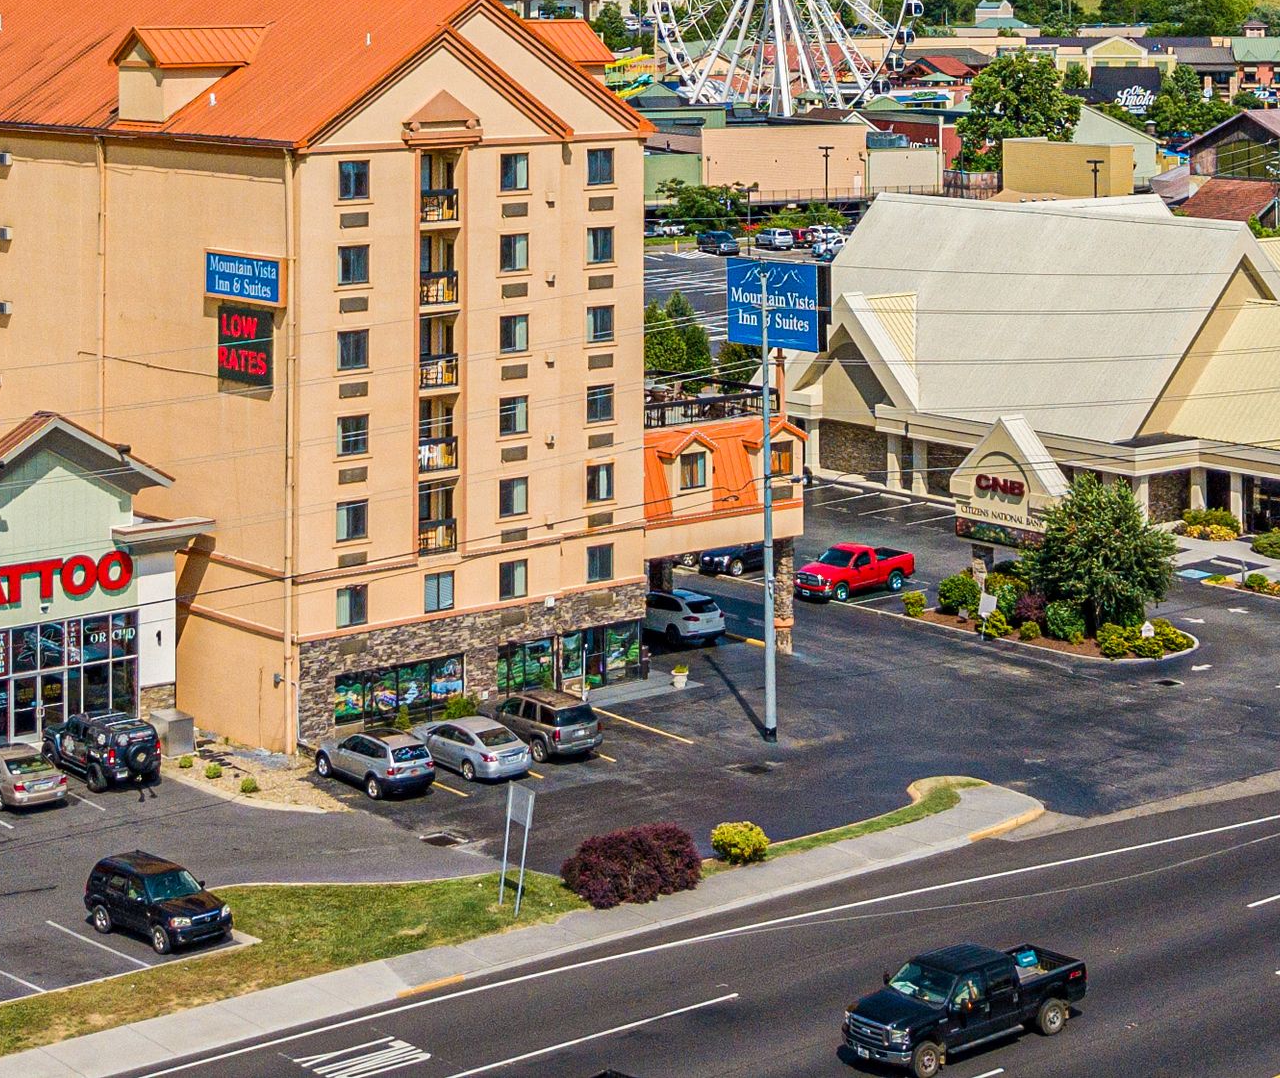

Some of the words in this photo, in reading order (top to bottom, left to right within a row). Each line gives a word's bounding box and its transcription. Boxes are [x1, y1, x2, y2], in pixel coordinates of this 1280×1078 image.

[1114, 88, 1157, 106] Smok
[210, 256, 253, 276] Mountain
[253, 261, 276, 279] Vista
[215, 275, 230, 291] Inn
[232, 278, 241, 293] &
[243, 279, 272, 298] Suites
[787, 292, 816, 310] Vista
[221, 313, 258, 339] LOW
[738, 309, 758, 326] Inn
[775, 313, 810, 332] Suites
[218, 346, 267, 375] RATES
[976, 474, 1025, 497] CNB
[960, 505, 989, 516] CITIZENS
[991, 511, 1024, 525] NATIONAL
